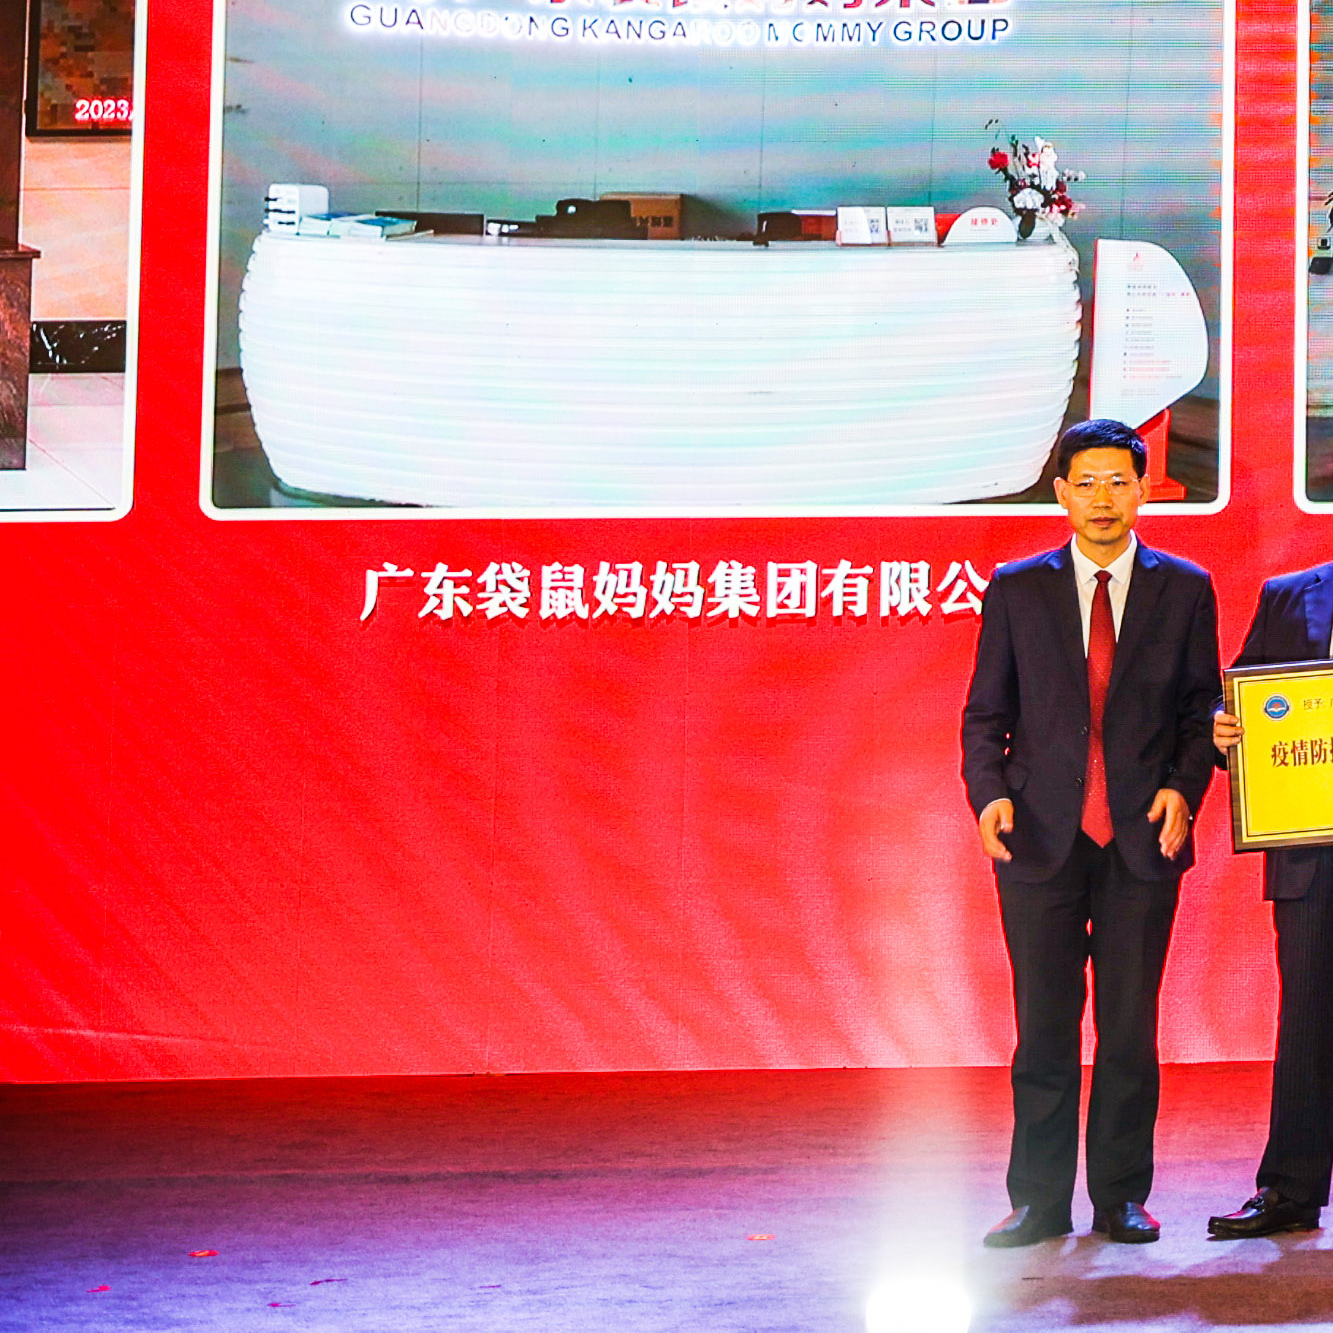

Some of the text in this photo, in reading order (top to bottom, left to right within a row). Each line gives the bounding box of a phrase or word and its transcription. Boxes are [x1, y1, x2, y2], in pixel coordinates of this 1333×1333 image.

[893, 18, 1009, 43] GROUP
[360, 560, 1007, 621] 广东袋鼠妈妈集团有限公
